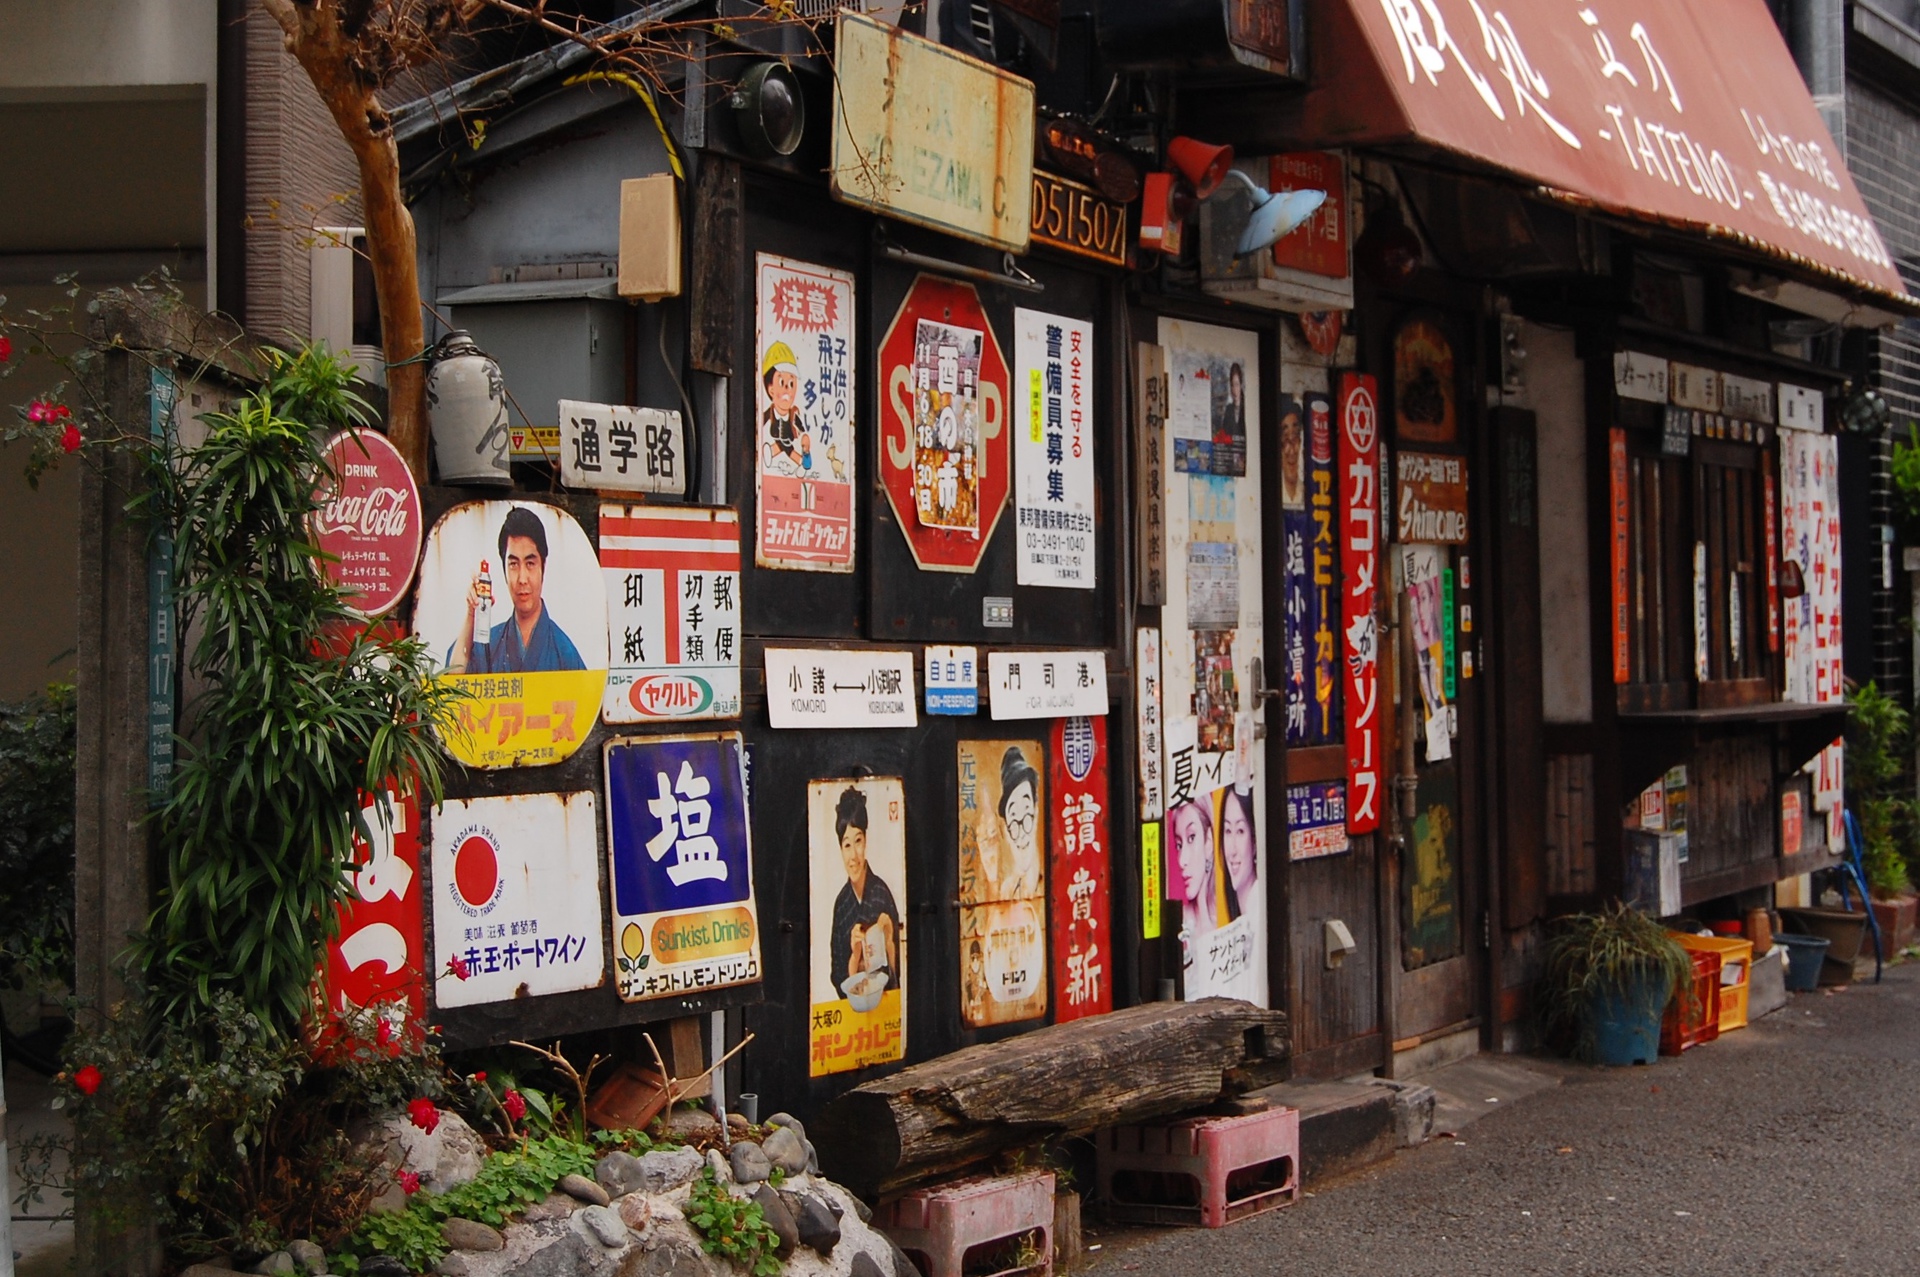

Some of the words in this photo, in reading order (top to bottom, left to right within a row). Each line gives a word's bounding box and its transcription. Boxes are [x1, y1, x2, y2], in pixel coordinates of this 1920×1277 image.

[781, 285, 829, 324] 注意
[818, 334, 834, 446] 飛出しが
[833, 338, 847, 420] 子供の
[1070, 330, 1082, 459] 安全を守る
[803, 379, 818, 432] 多い
[1046, 324, 1064, 503] 警備員募集
[571, 417, 676, 478] 通学路
[937, 345, 961, 512] 酉の市
[345, 464, 379, 478] DRINK
[765, 518, 848, 550] ヨットスポーツウェア
[1026, 532, 1085, 552] 03-3491-1040
[1349, 457, 1376, 597] カゴメ
[623, 573, 645, 664] 印紙
[685, 574, 704, 662] 切手類
[713, 575, 734, 662] 郵便
[153, 653, 172, 695] 17
[456, 677, 524, 700] 強力殺虫剤
[789, 665, 826, 694] 小諸
[931, 661, 972, 683] 自由席
[1008, 661, 1089, 690] 門司港
[645, 683, 699, 708] ヤクルト
[713, 701, 738, 713] 申込所
[791, 698, 827, 713] KOMORO
[868, 701, 905, 714] KOBUCHIZAWA
[1026, 697, 1042, 709] FOR
[455, 700, 577, 746] ハイアース
[1354, 677, 1377, 823] ソース
[960, 754, 977, 811] 元気
[1169, 744, 1226, 810] 夏ハイ
[451, 824, 478, 856] AKADAMA
[481, 825, 500, 852] BRAND
[645, 760, 729, 887] 塩
[449, 882, 478, 918] REGISTERED
[480, 902, 497, 918] TRADE
[494, 878, 505, 902] MARK
[464, 926, 484, 942] 美味
[657, 923, 710, 952] Sunkist
[713, 919, 751, 946] Drinks
[464, 934, 587, 977] 赤玉ポートワイン
[619, 972, 680, 998] サンキスト
[683, 967, 716, 989] レモン
[718, 960, 758, 982] ドリンク
[1002, 970, 1026, 986] ドリンク
[813, 1009, 842, 1030] 大塚の
[812, 1024, 902, 1062] ボンカレー
